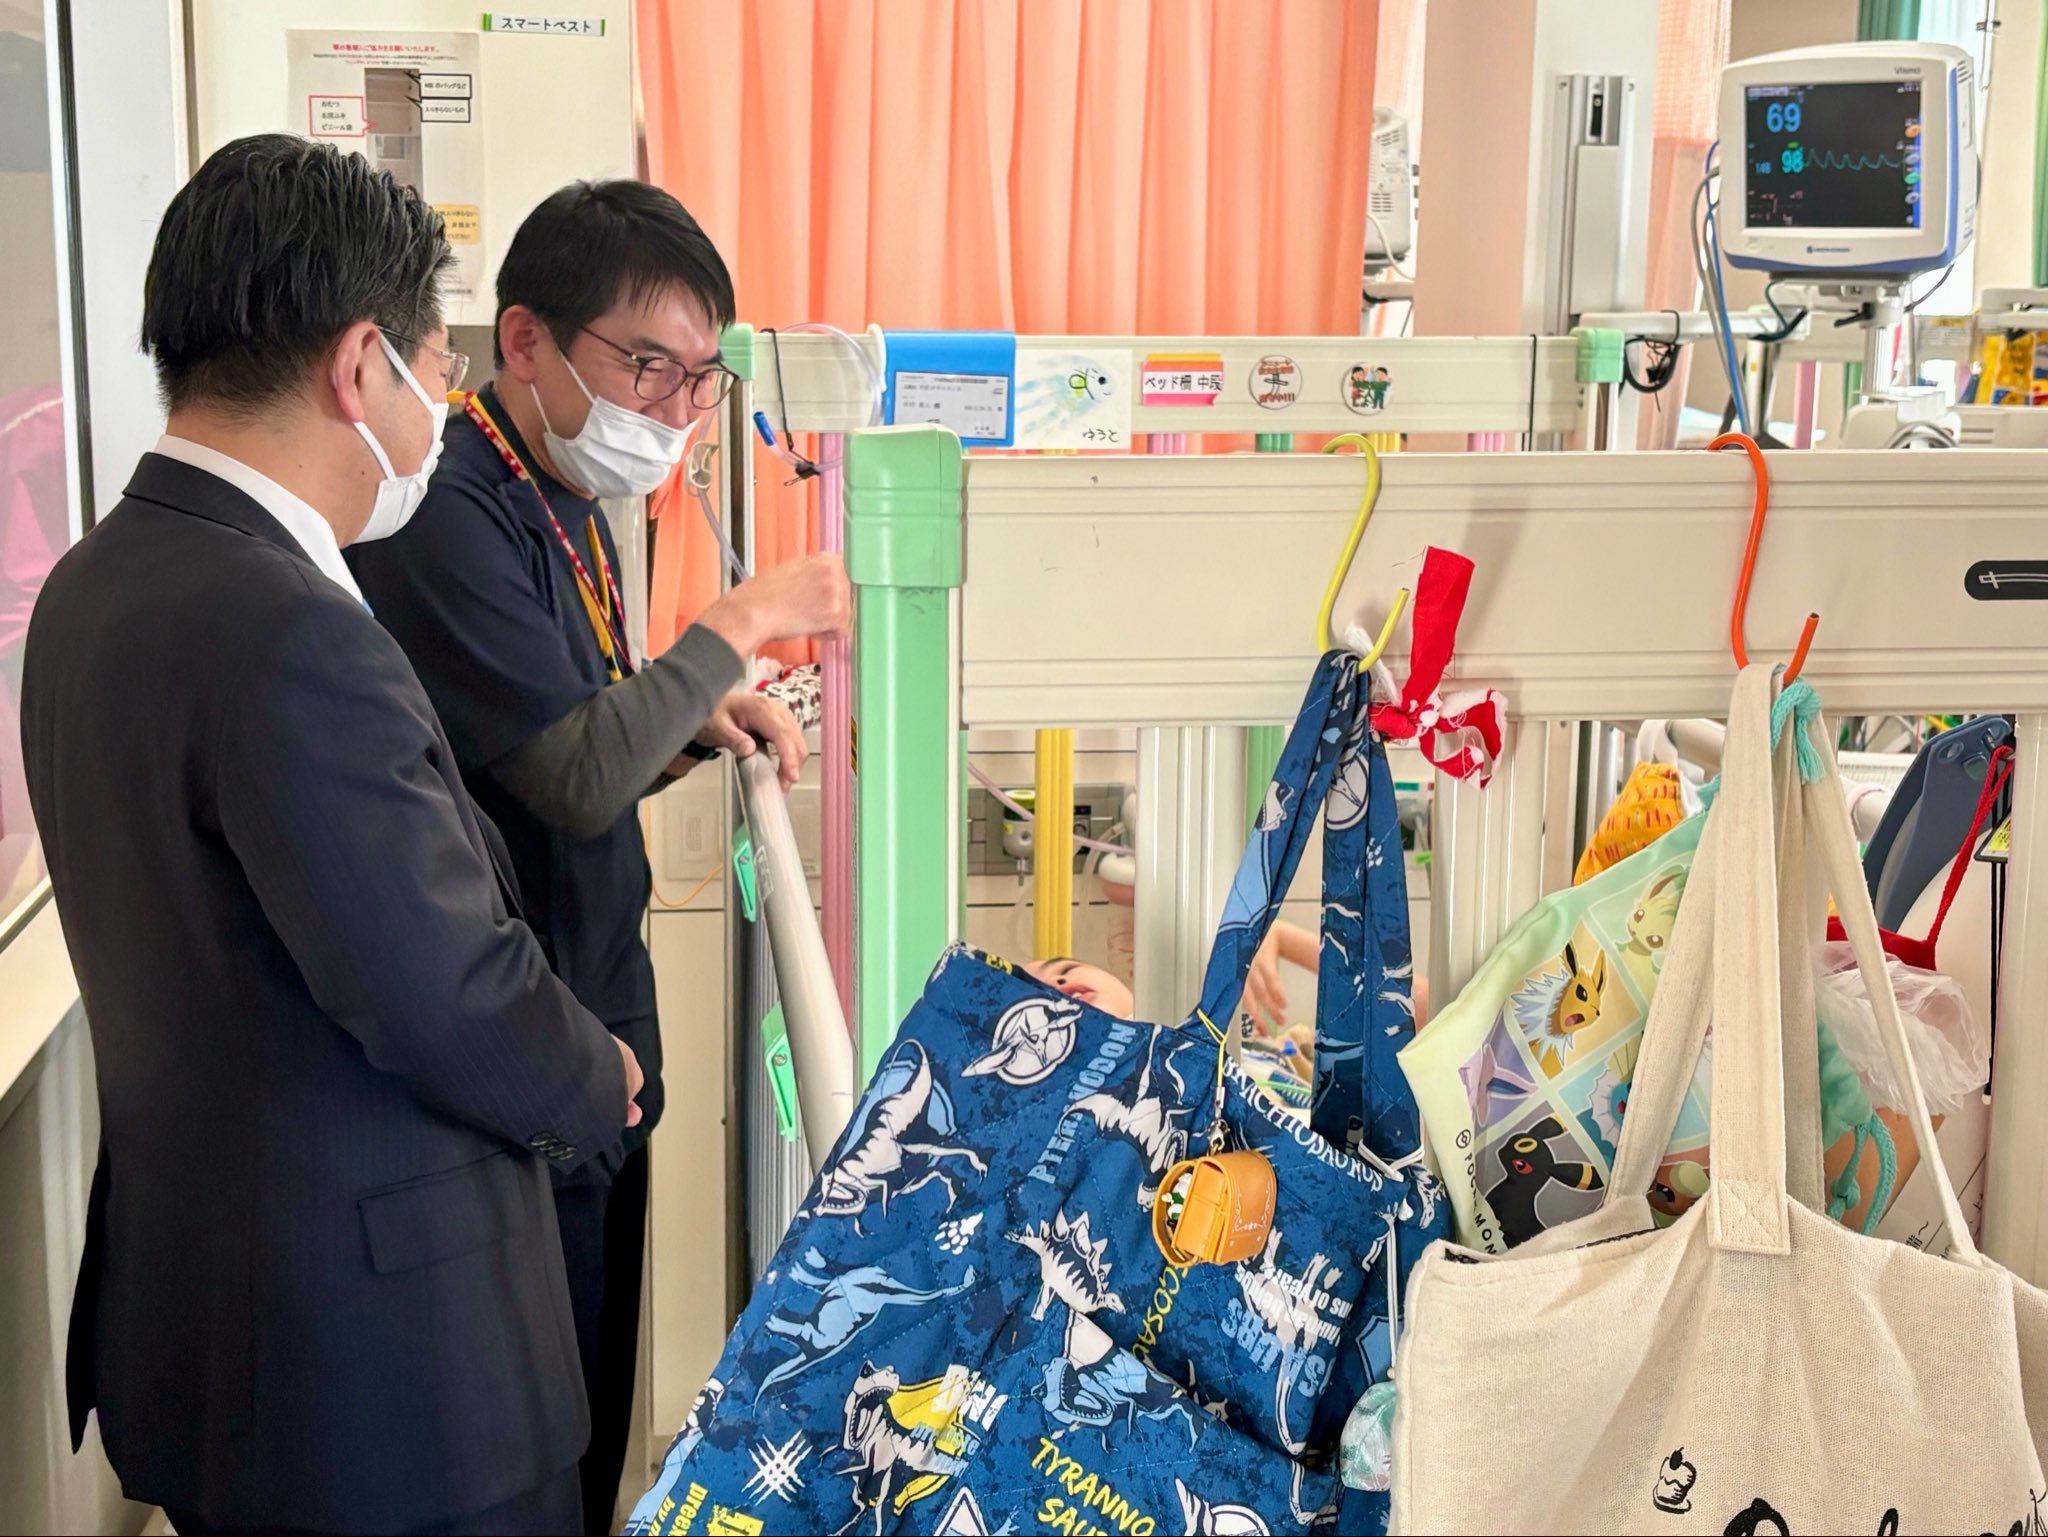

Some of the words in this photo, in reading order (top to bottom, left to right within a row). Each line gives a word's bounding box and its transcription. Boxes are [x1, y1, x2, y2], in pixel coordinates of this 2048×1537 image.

[1766, 102, 1801, 133] 69
[1781, 149, 1803, 173] 98
[1082, 428, 1120, 443] ゆうと
[1031, 1437, 1156, 1536] TYRANNO
